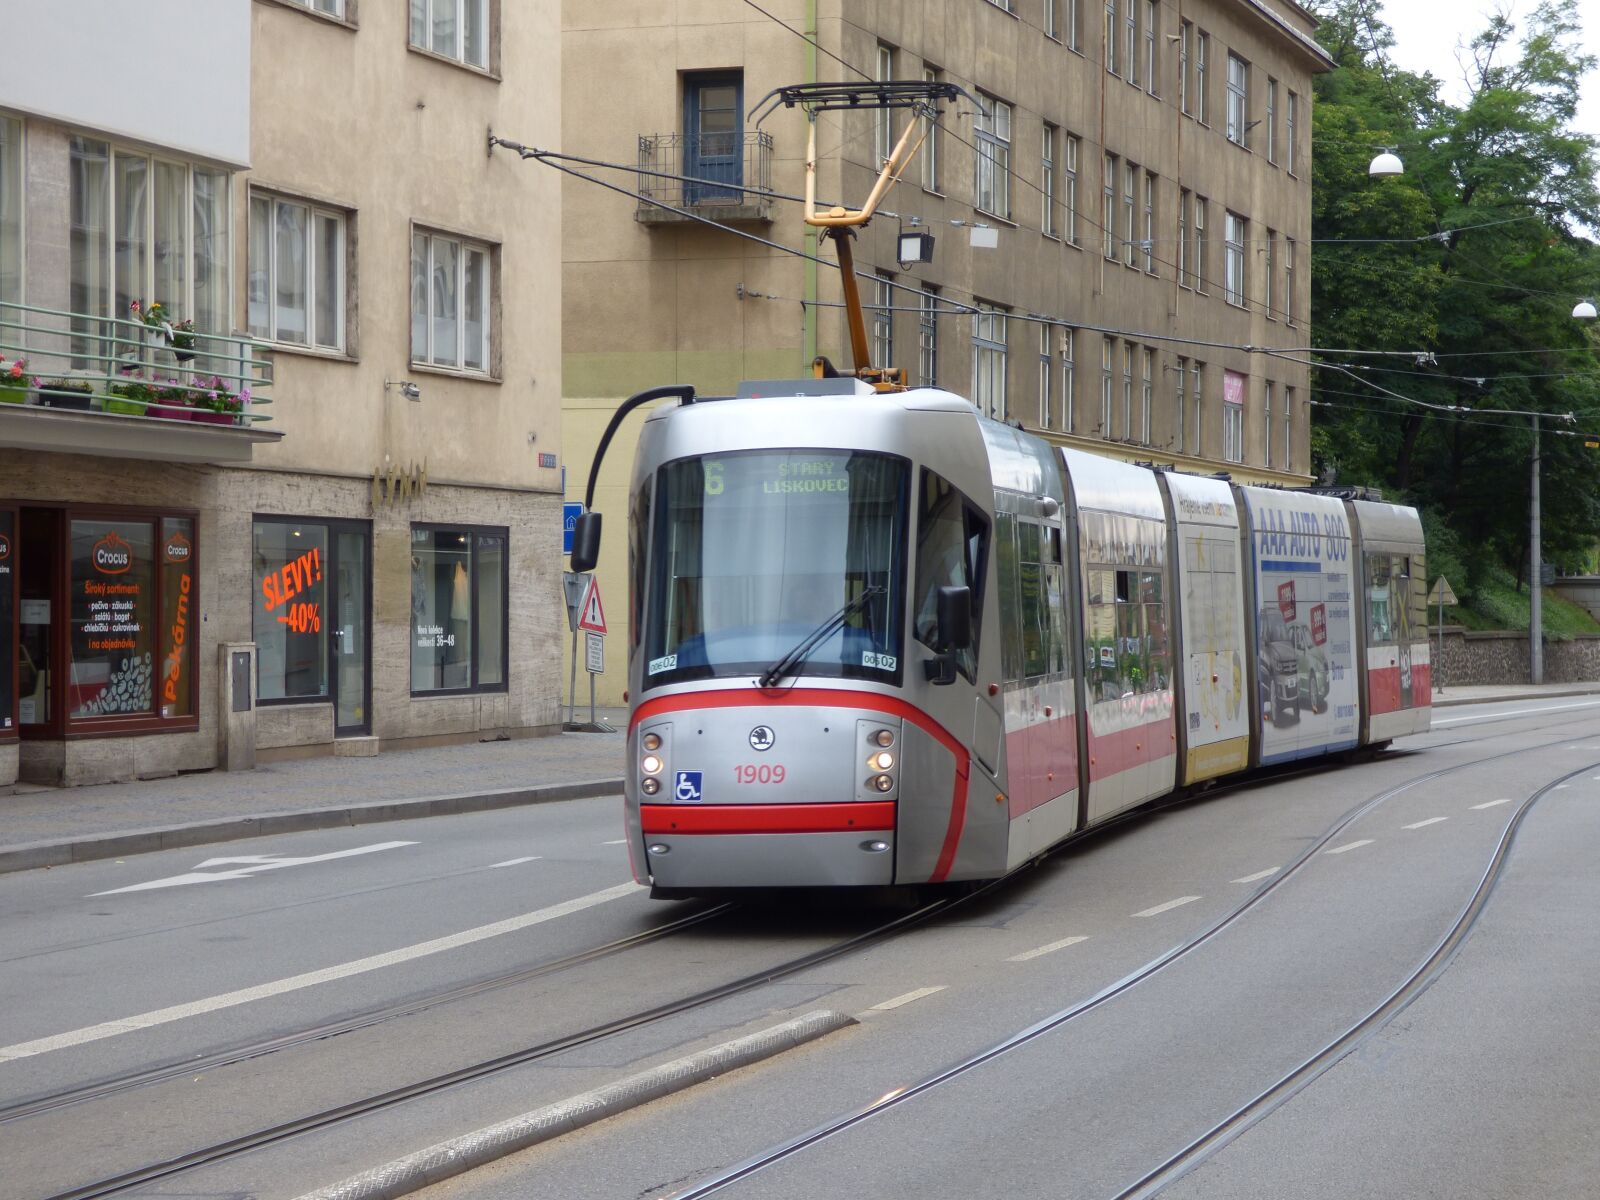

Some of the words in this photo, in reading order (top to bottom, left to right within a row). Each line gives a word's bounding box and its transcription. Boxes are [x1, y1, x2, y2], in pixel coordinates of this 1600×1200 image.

[705, 463, 724, 495] 6
[1260, 508, 1287, 556] AAA
[1290, 511, 1321, 558] AUTO
[97, 549, 128, 564] Crocus
[167, 545, 188, 555] Crocus
[85, 580, 106, 596] Široký
[262, 547, 320, 611] SLEVY!
[91, 601, 108, 612] pečiva
[276, 603, 320, 633] -40%
[101, 639, 136, 650] objednávku
[164, 574, 190, 701] Pekárna
[734, 764, 785, 784] 1909
